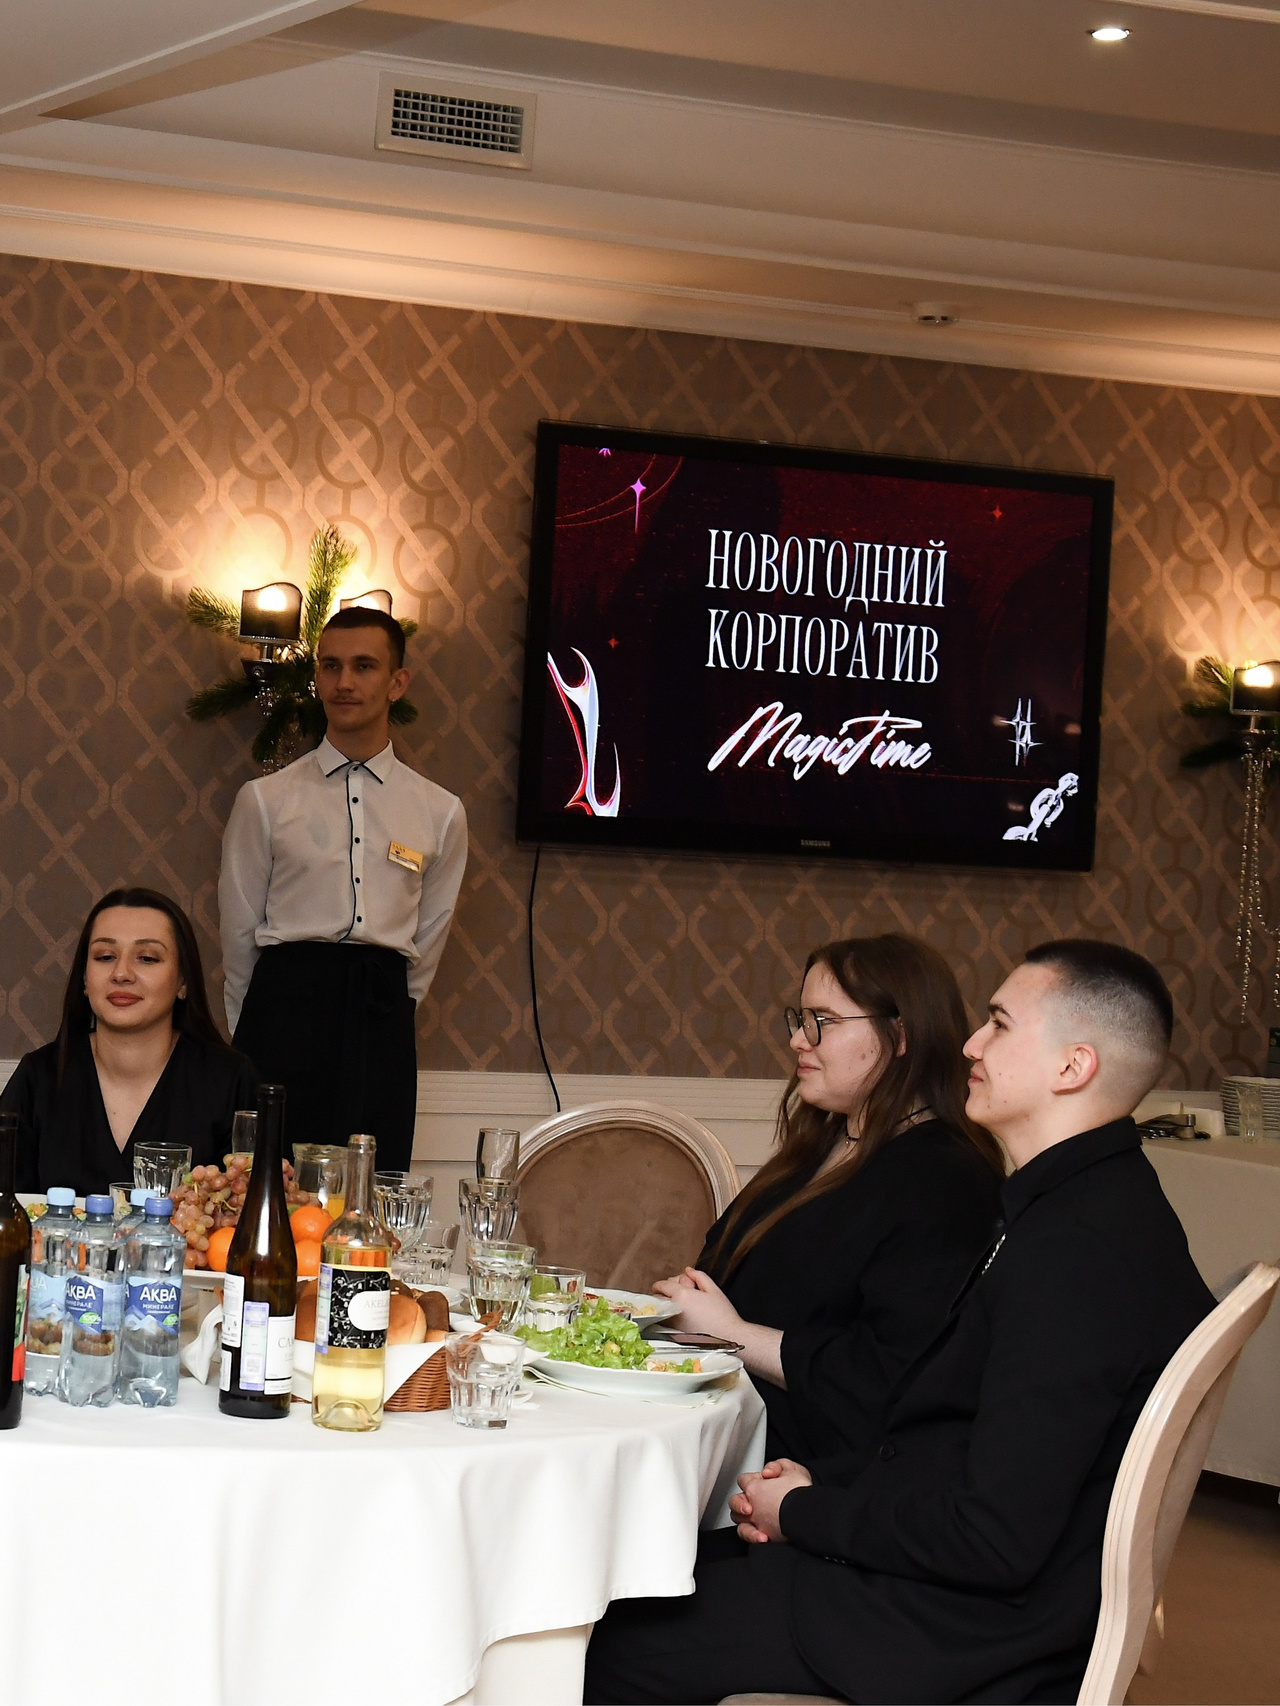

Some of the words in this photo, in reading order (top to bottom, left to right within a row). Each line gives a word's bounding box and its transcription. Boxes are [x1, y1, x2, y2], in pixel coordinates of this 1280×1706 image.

[705, 528, 948, 614] НОВОГОДНИЙ
[705, 608, 939, 684] КОРПОРАТИВ
[707, 701, 933, 781] MagicTime
[139, 1285, 177, 1304] АКВА
